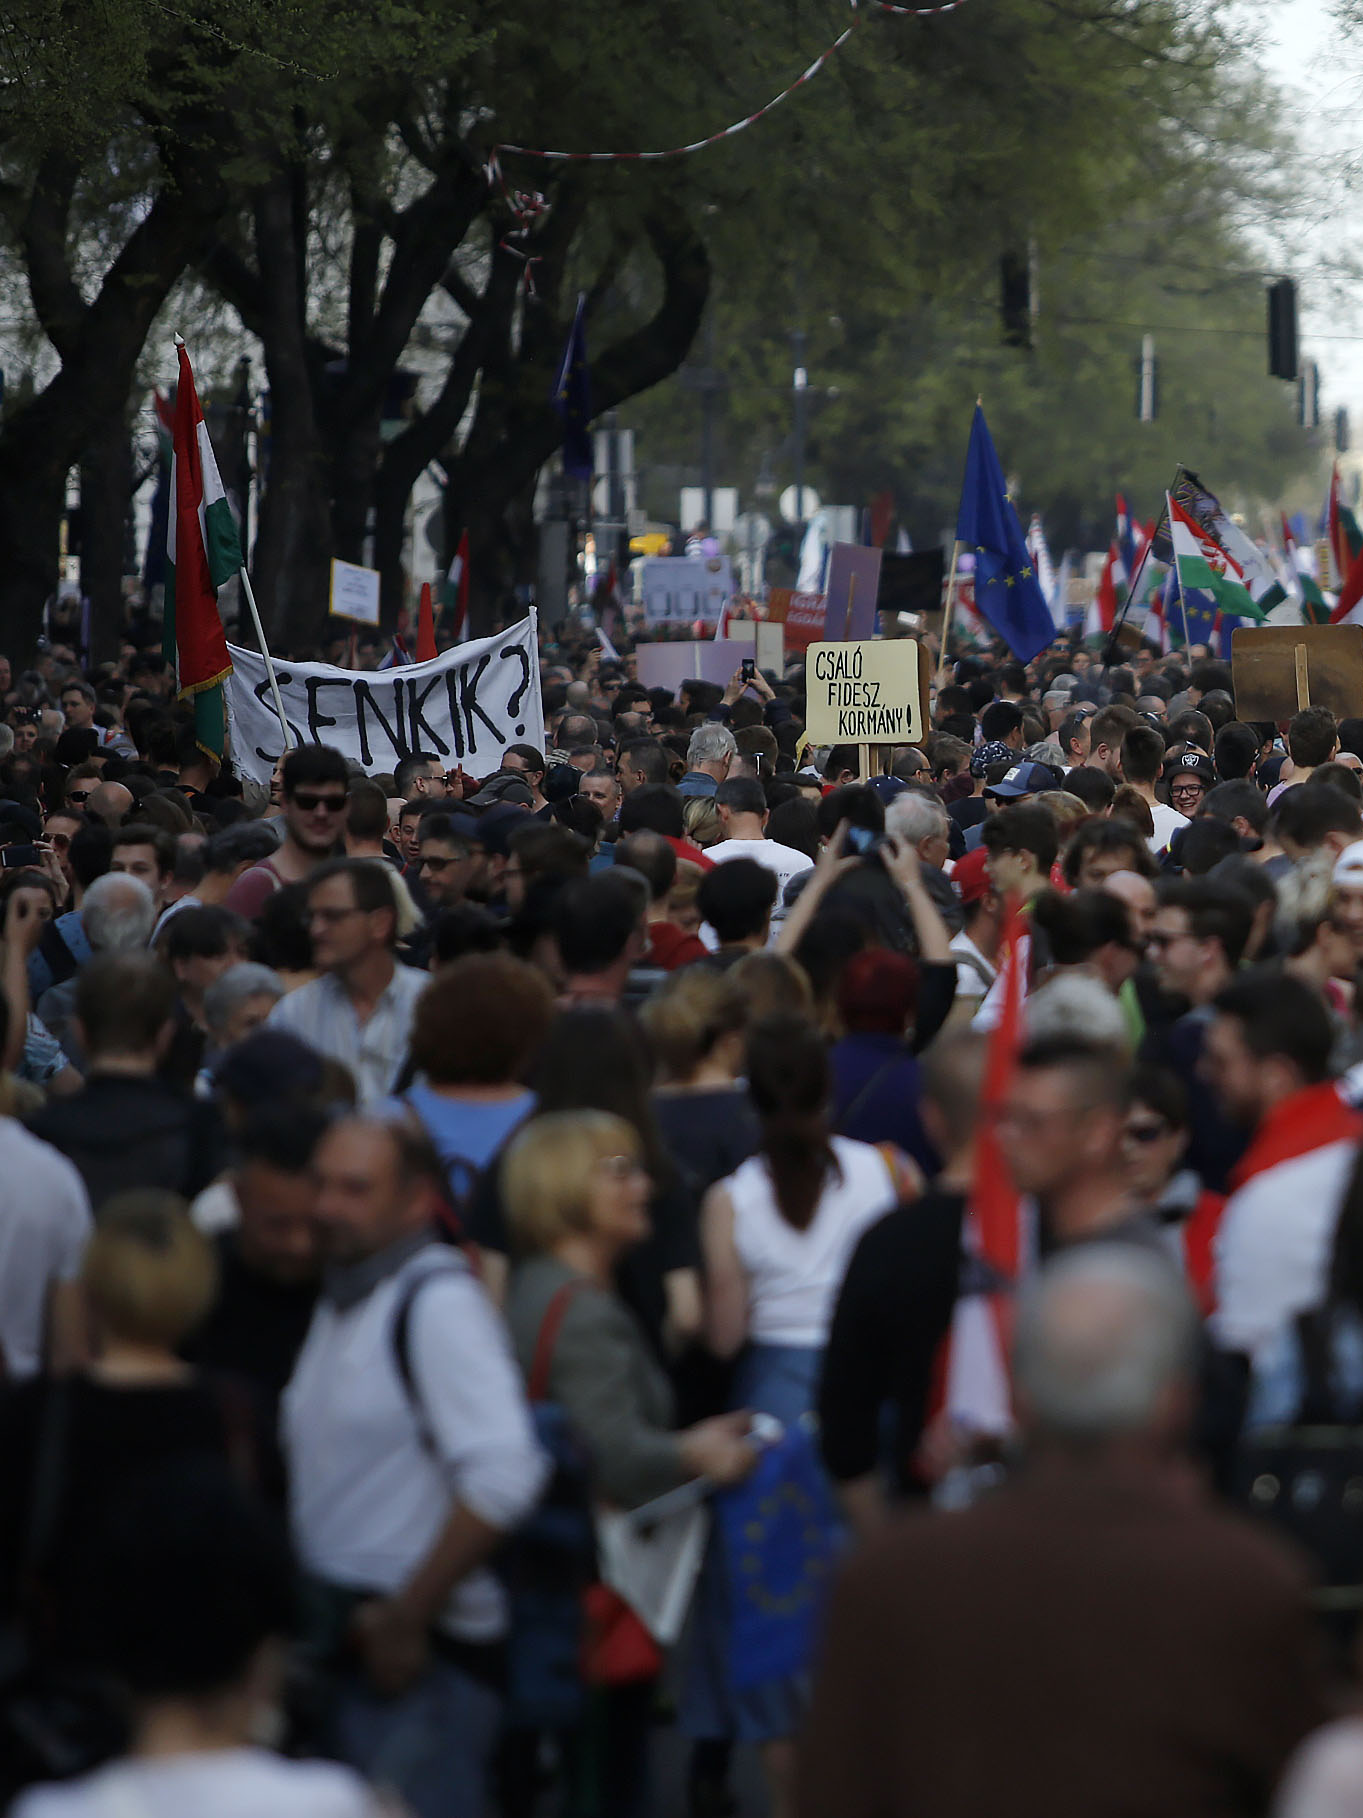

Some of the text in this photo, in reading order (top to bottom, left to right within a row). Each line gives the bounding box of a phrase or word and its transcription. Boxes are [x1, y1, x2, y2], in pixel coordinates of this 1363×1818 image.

[816, 645, 863, 681] CSALÓ
[254, 645, 531, 766] SENKIK?
[827, 682, 881, 708] FIDESZ
